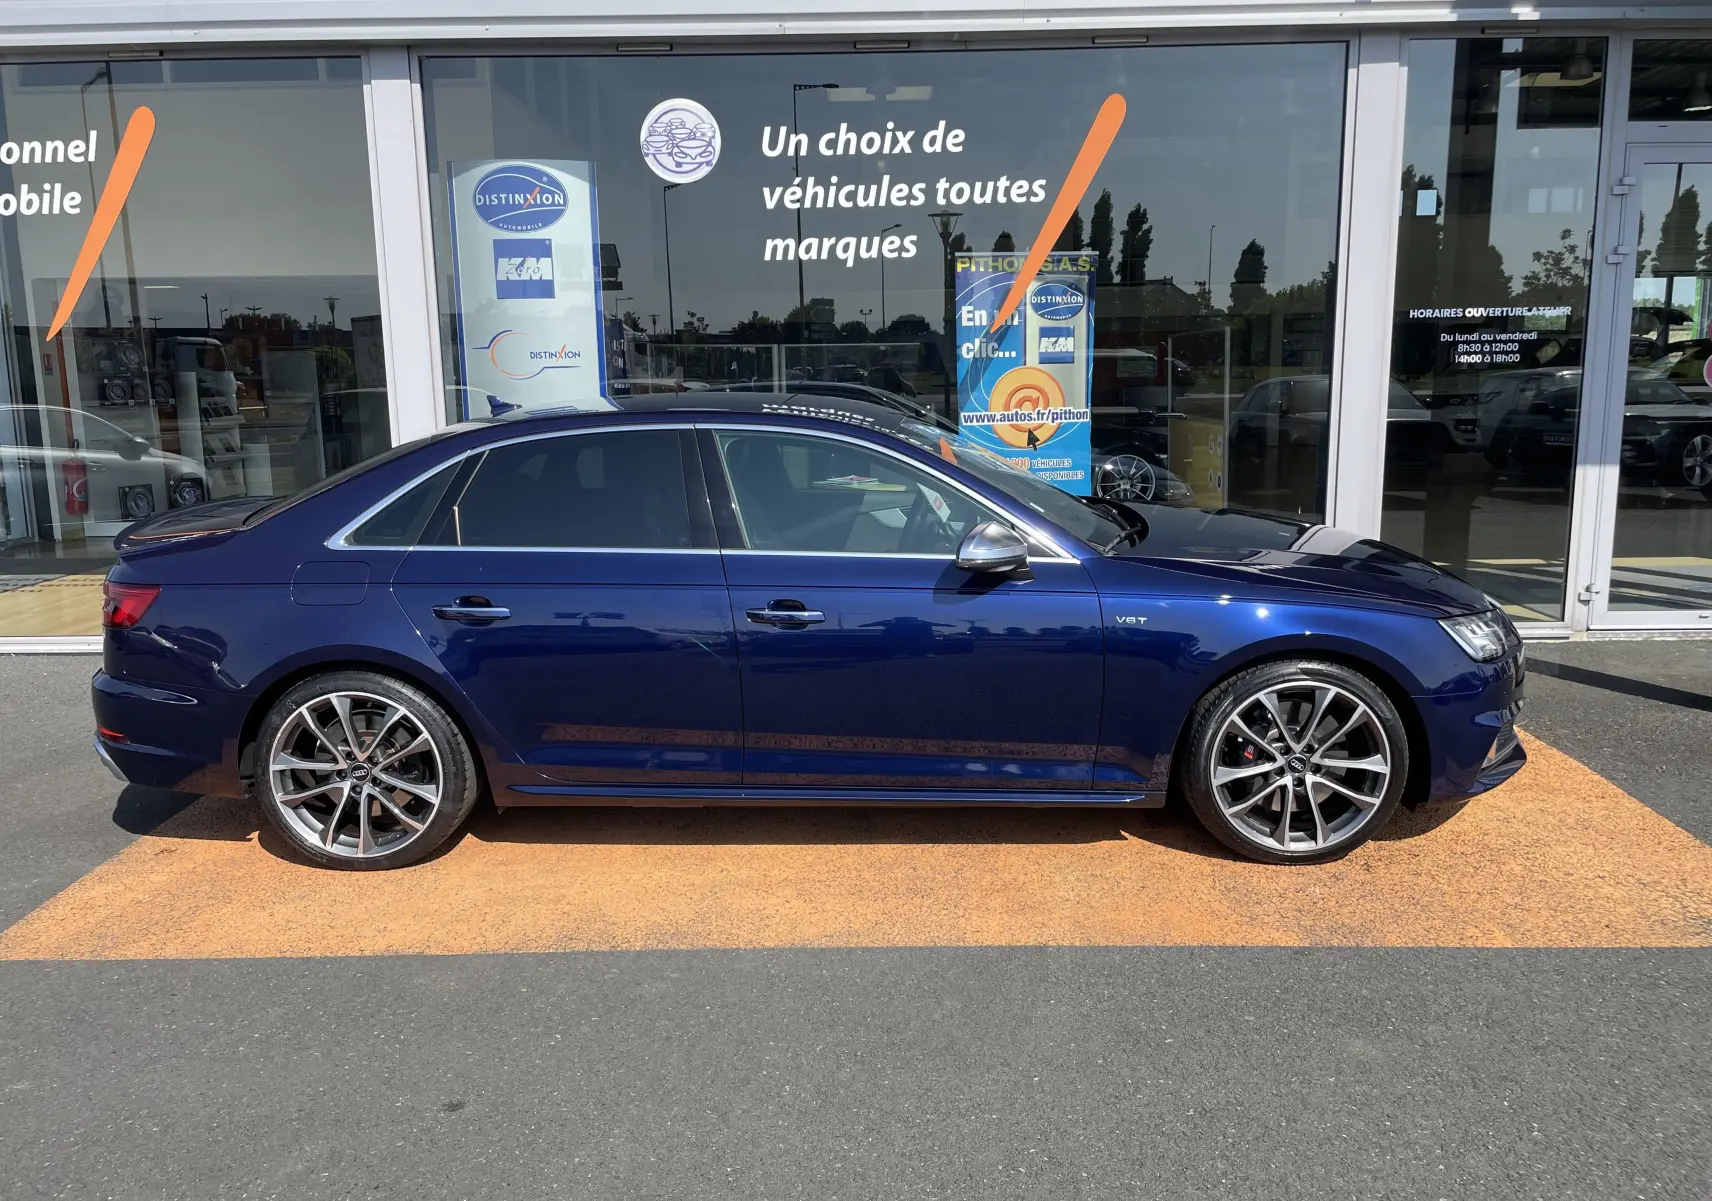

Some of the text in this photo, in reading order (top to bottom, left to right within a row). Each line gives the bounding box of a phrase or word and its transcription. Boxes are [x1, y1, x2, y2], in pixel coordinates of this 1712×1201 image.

[761, 120, 966, 157] Un choix de
[762, 174, 1047, 209] véhicules toutes
[476, 190, 564, 207] DISTINXION
[499, 222, 543, 230] AUTOMOBILE
[764, 234, 918, 268] marques
[1032, 294, 1083, 304] DISTINXION
[962, 306, 987, 326] En
[1409, 308, 1463, 318] HORAIRES
[1465, 307, 1528, 317] OUVERTURE
[1441, 334, 1454, 342] Du
[1456, 333, 1478, 341] lundi
[1495, 332, 1537, 340] vendredi
[962, 338, 1017, 358] clic...
[1458, 343, 1519, 352] 8h30 à 12h00
[530, 348, 581, 361] DISTINXION
[1455, 354, 1520, 363] 14h00 à 18h00
[962, 408, 1089, 426] www.autos.fr/pithon
[1032, 457, 1072, 468] VÉHICULES
[1116, 616, 1147, 624] V6T
